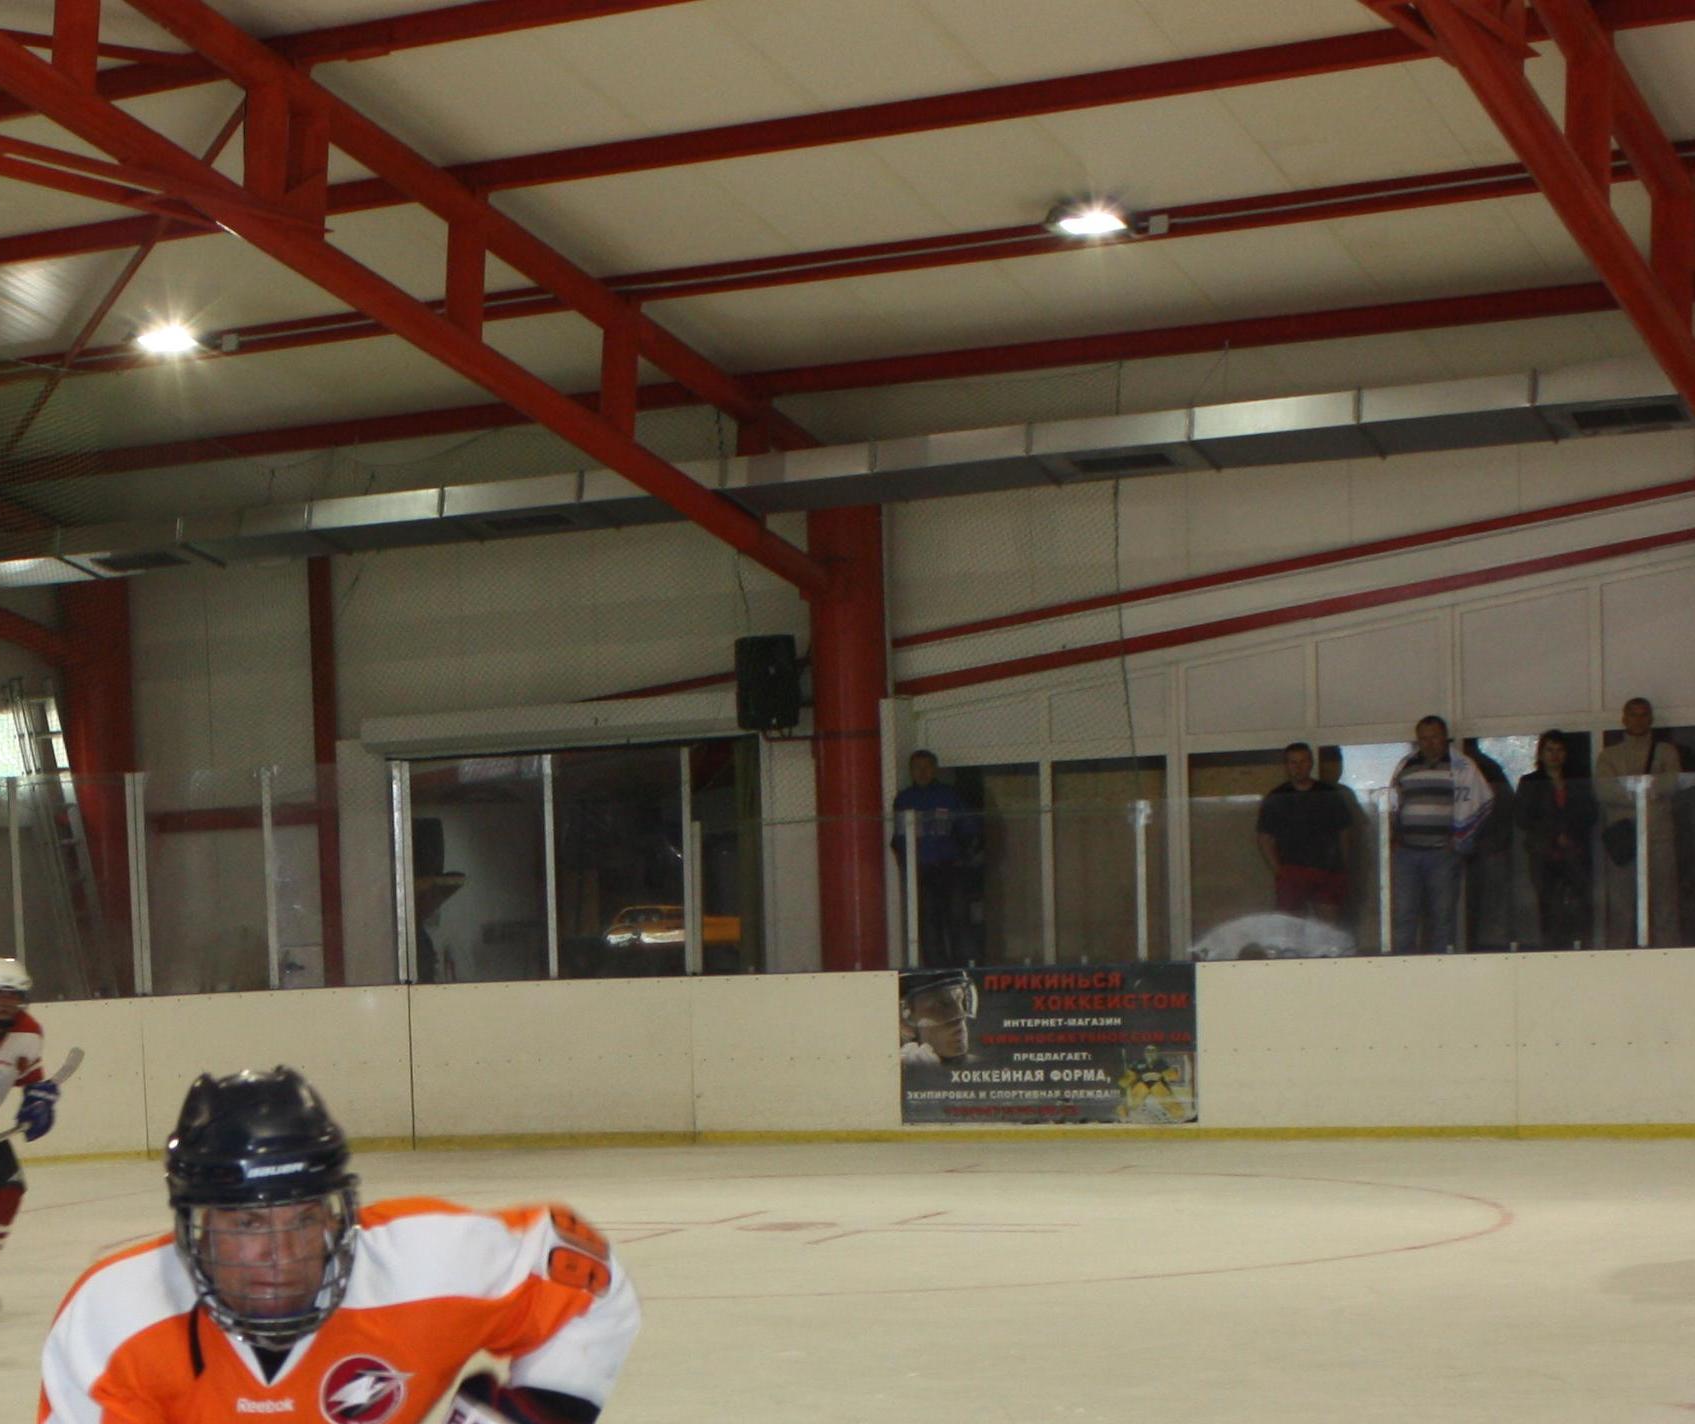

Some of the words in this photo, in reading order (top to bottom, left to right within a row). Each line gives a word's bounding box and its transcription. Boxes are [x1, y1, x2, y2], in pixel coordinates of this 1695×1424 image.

[983, 971, 1123, 991] ПРИКИНЬСЯ
[1003, 1017, 1122, 1028] ИНТЕРНЕТ-МАГАЗИН
[1013, 1051, 1092, 1062] ПРЕДЛАГАЕТ:
[951, 1068, 1044, 1083] ХОККЕЙНАЯ
[1049, 1069, 1112, 1084] ФОРМА,
[980, 1090, 988, 1100] И
[990, 1089, 1059, 1099] СПОРТИВНАЯ
[236, 1396, 294, 1413] Reebok
